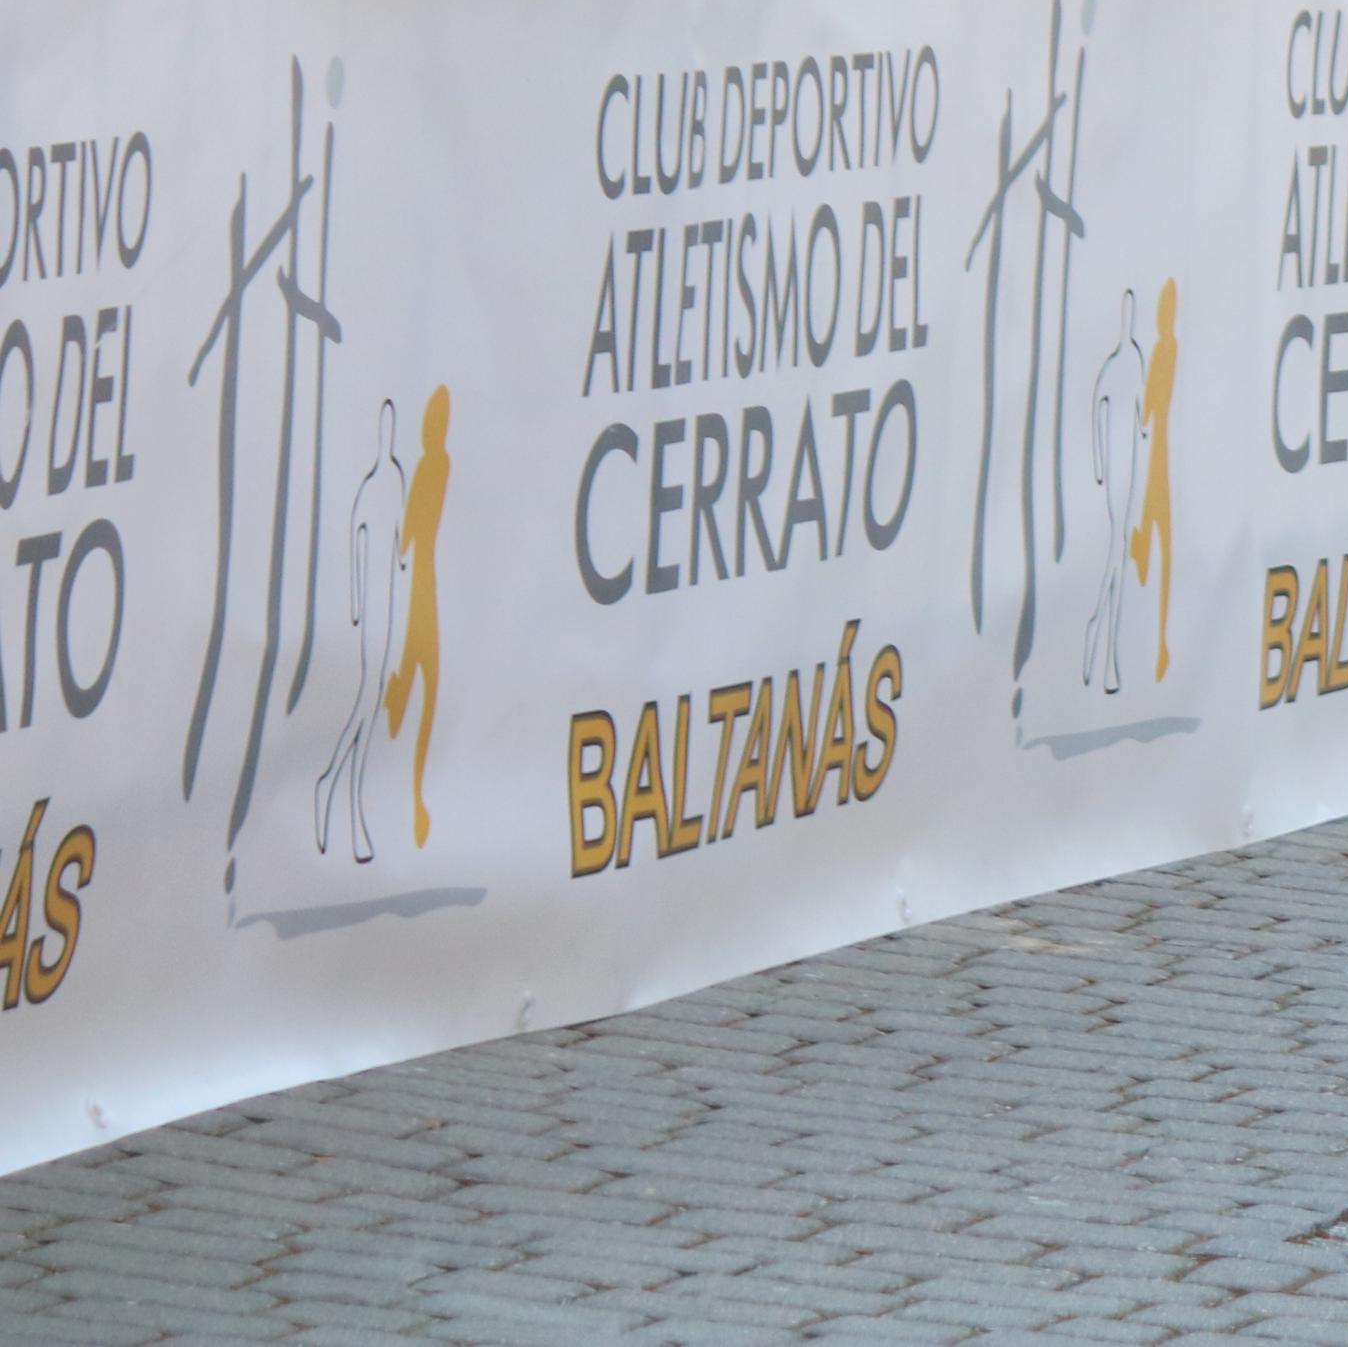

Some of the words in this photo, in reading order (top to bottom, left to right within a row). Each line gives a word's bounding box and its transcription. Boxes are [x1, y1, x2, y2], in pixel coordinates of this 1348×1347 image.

[597, 69, 708, 201] CLUB
[717, 45, 940, 187] DEPORTIVO
[582, 203, 840, 397] ATLETISMO
[857, 195, 929, 358] DEL
[47, 304, 136, 495] DEL
[574, 379, 918, 606] CERRATO
[567, 619, 903, 878] BALTANÁS
